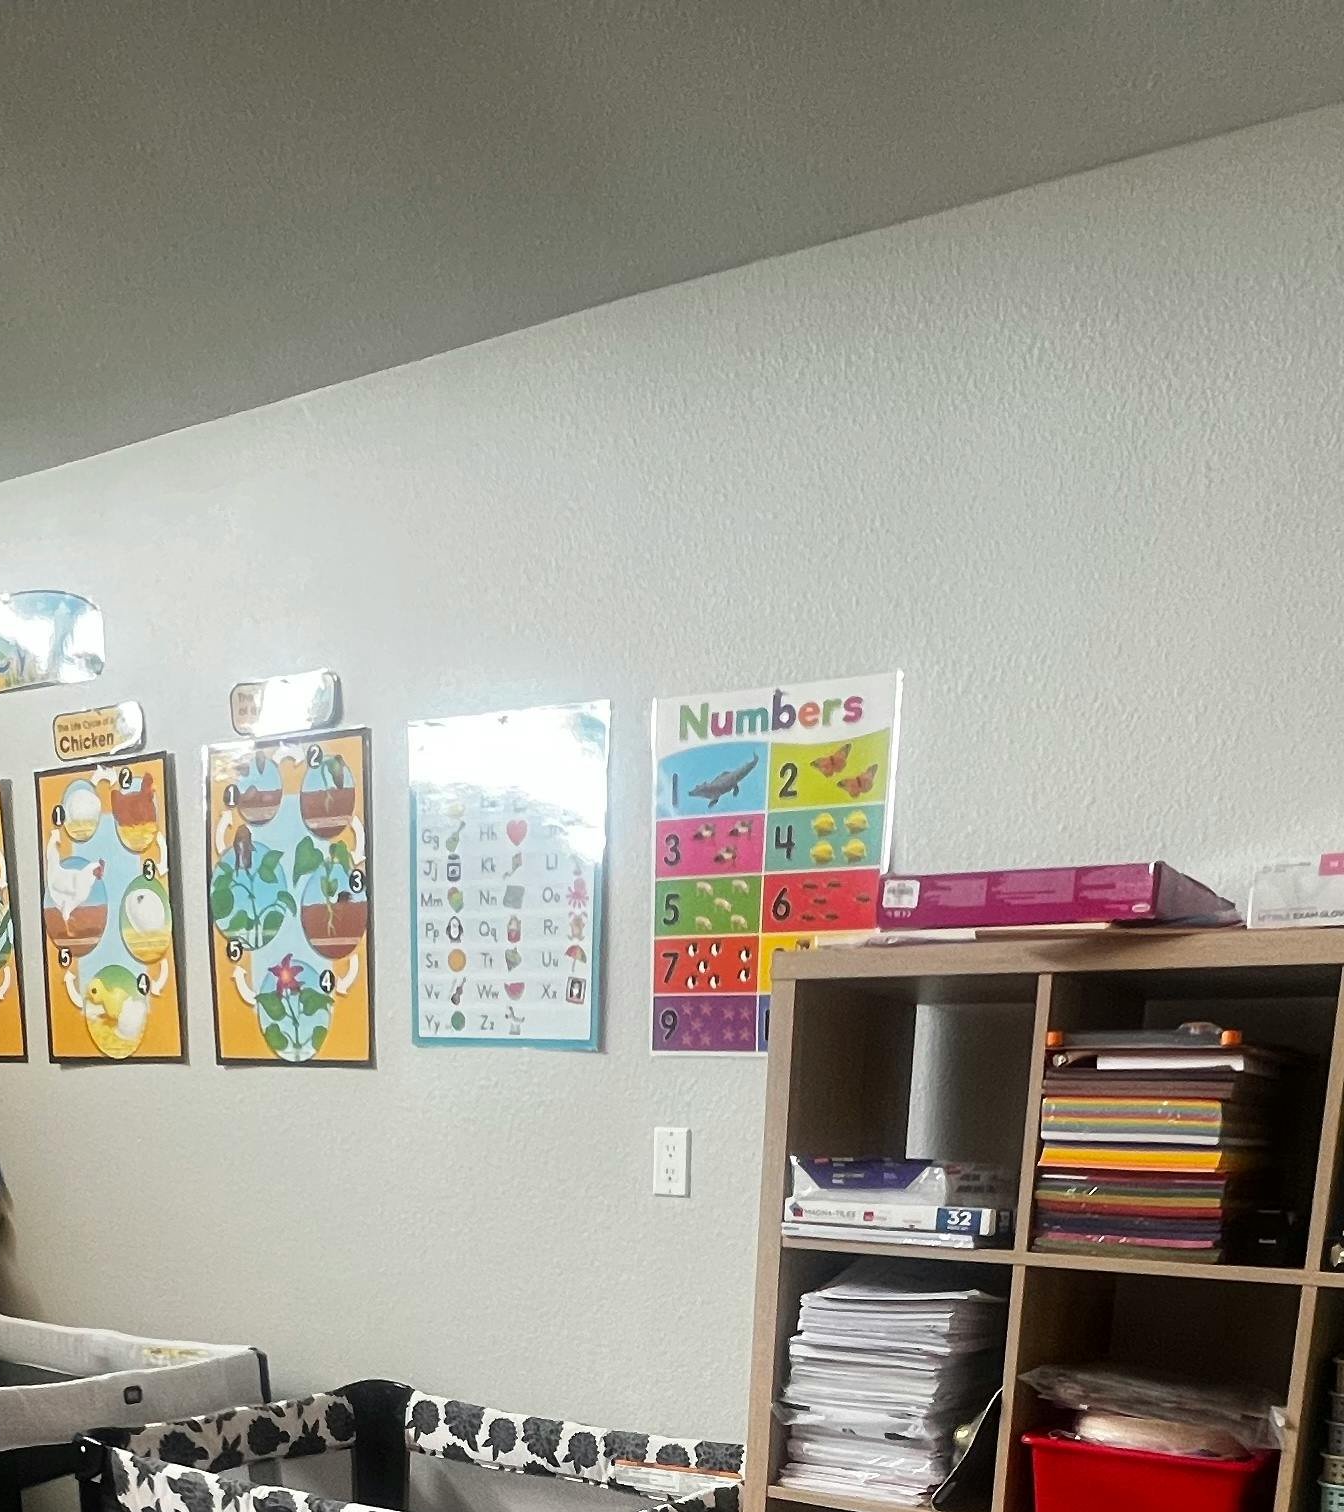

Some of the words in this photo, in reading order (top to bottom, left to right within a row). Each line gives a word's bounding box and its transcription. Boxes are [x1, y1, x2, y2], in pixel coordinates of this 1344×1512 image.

[679, 688, 864, 741] Numbers
[59, 731, 115, 753] Chicken
[309, 746, 321, 768] 2
[120, 768, 131, 789] 2
[672, 772, 678, 806] 1
[778, 762, 798, 799] 2
[227, 786, 236, 806] 1
[55, 806, 63, 826] 1
[422, 829, 440, 851] Gg
[479, 823, 497, 842] Hh
[775, 825, 795, 860] 4
[664, 834, 681, 867] 3
[144, 860, 155, 880] 3
[424, 860, 438, 882] Jj
[481, 857, 496, 873] Kk
[352, 870, 362, 892] 3
[420, 893, 443, 907] Mm
[479, 891, 498, 906] Nn
[542, 886, 561, 904] Oo
[771, 887, 791, 921] 6
[663, 893, 681, 926] 5
[1293, 911, 1318, 920] EXAM
[425, 922, 440, 943] Pp
[479, 920, 498, 944] Qq
[544, 918, 559, 935] Rr
[60, 948, 70, 967] 5
[229, 940, 240, 961] 5
[425, 953, 439, 969] Ss
[480, 952, 495, 969] Tt
[541, 952, 559, 968] Uu
[662, 952, 680, 984] 7
[138, 974, 148, 995] 4
[321, 971, 332, 992] 4
[424, 984, 441, 1000] Vv
[477, 983, 500, 1000] Ww
[541, 984, 558, 1000] Xx
[425, 1015, 441, 1035] Yy
[480, 1014, 495, 1031] Zz
[660, 1009, 678, 1041] 9
[947, 1210, 972, 1227] 32
